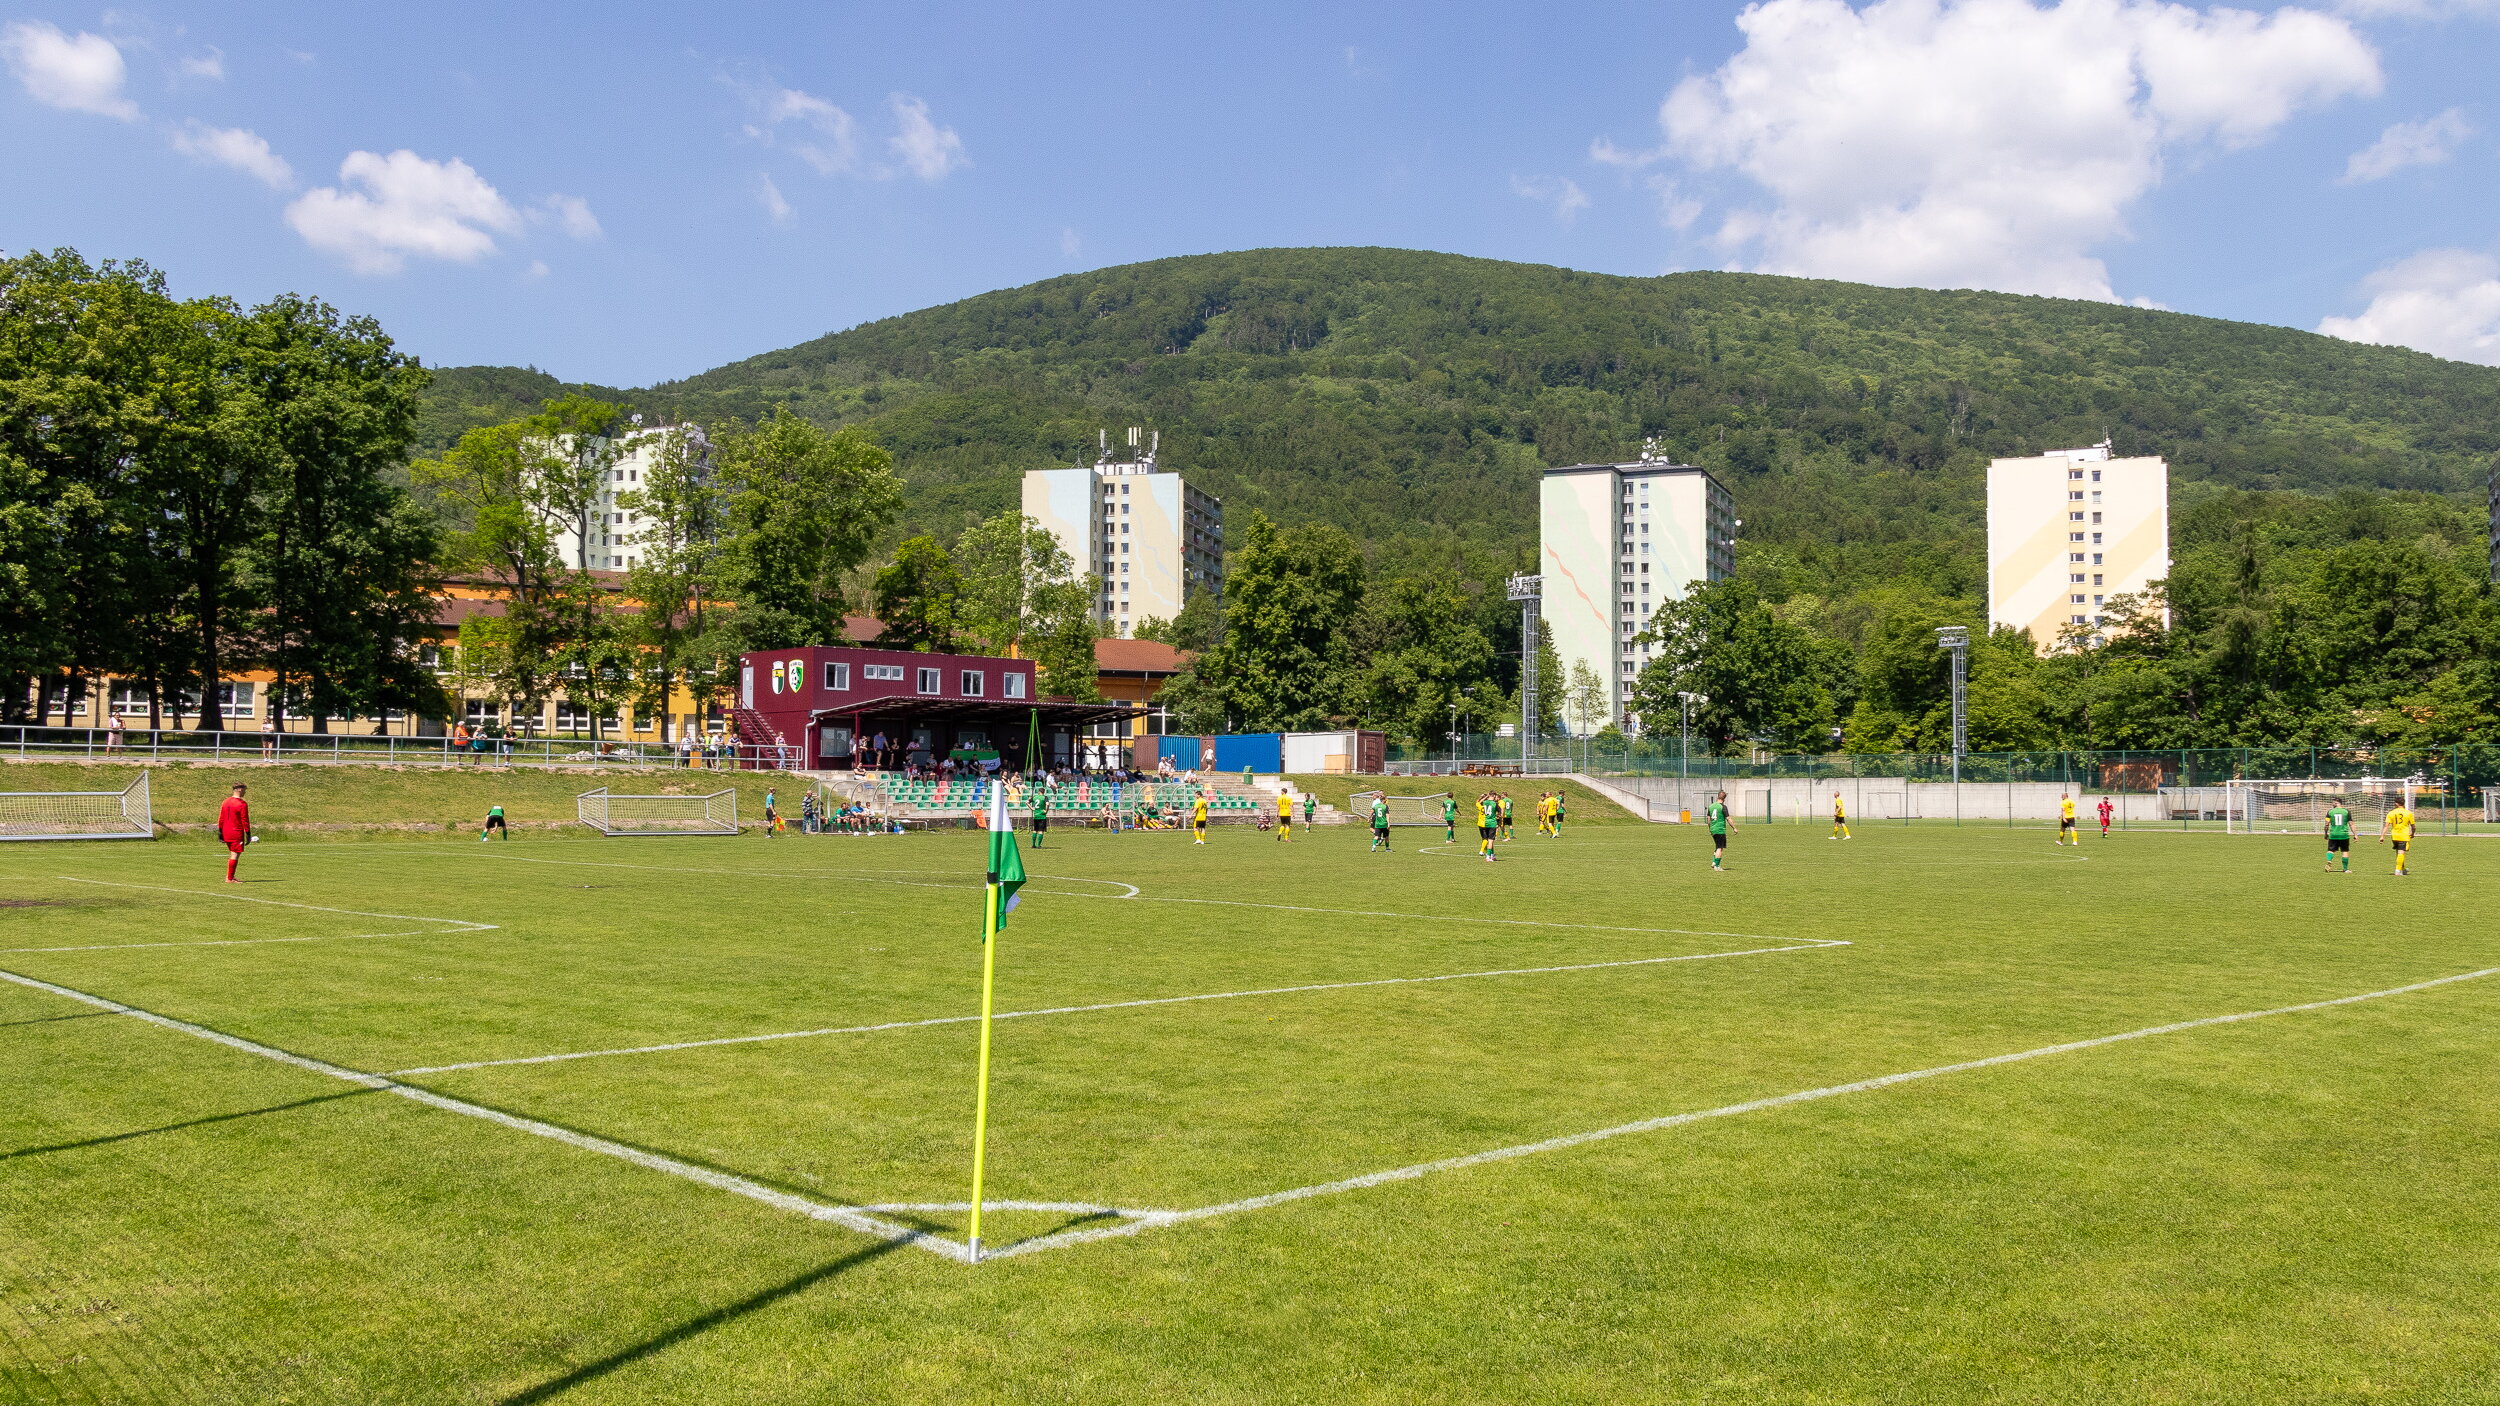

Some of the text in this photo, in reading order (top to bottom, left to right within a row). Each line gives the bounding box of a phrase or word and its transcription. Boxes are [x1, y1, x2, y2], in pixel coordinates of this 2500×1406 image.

[1035, 799, 1040, 809] 2
[1446, 803, 1451, 811] 3
[1505, 801, 1510, 809] 8
[1377, 807, 1383, 817] 5
[1484, 805, 1492, 816] 14
[1711, 809, 1718, 820] 4
[2333, 813, 2343, 826] 11
[2394, 814, 2403, 825] 13
